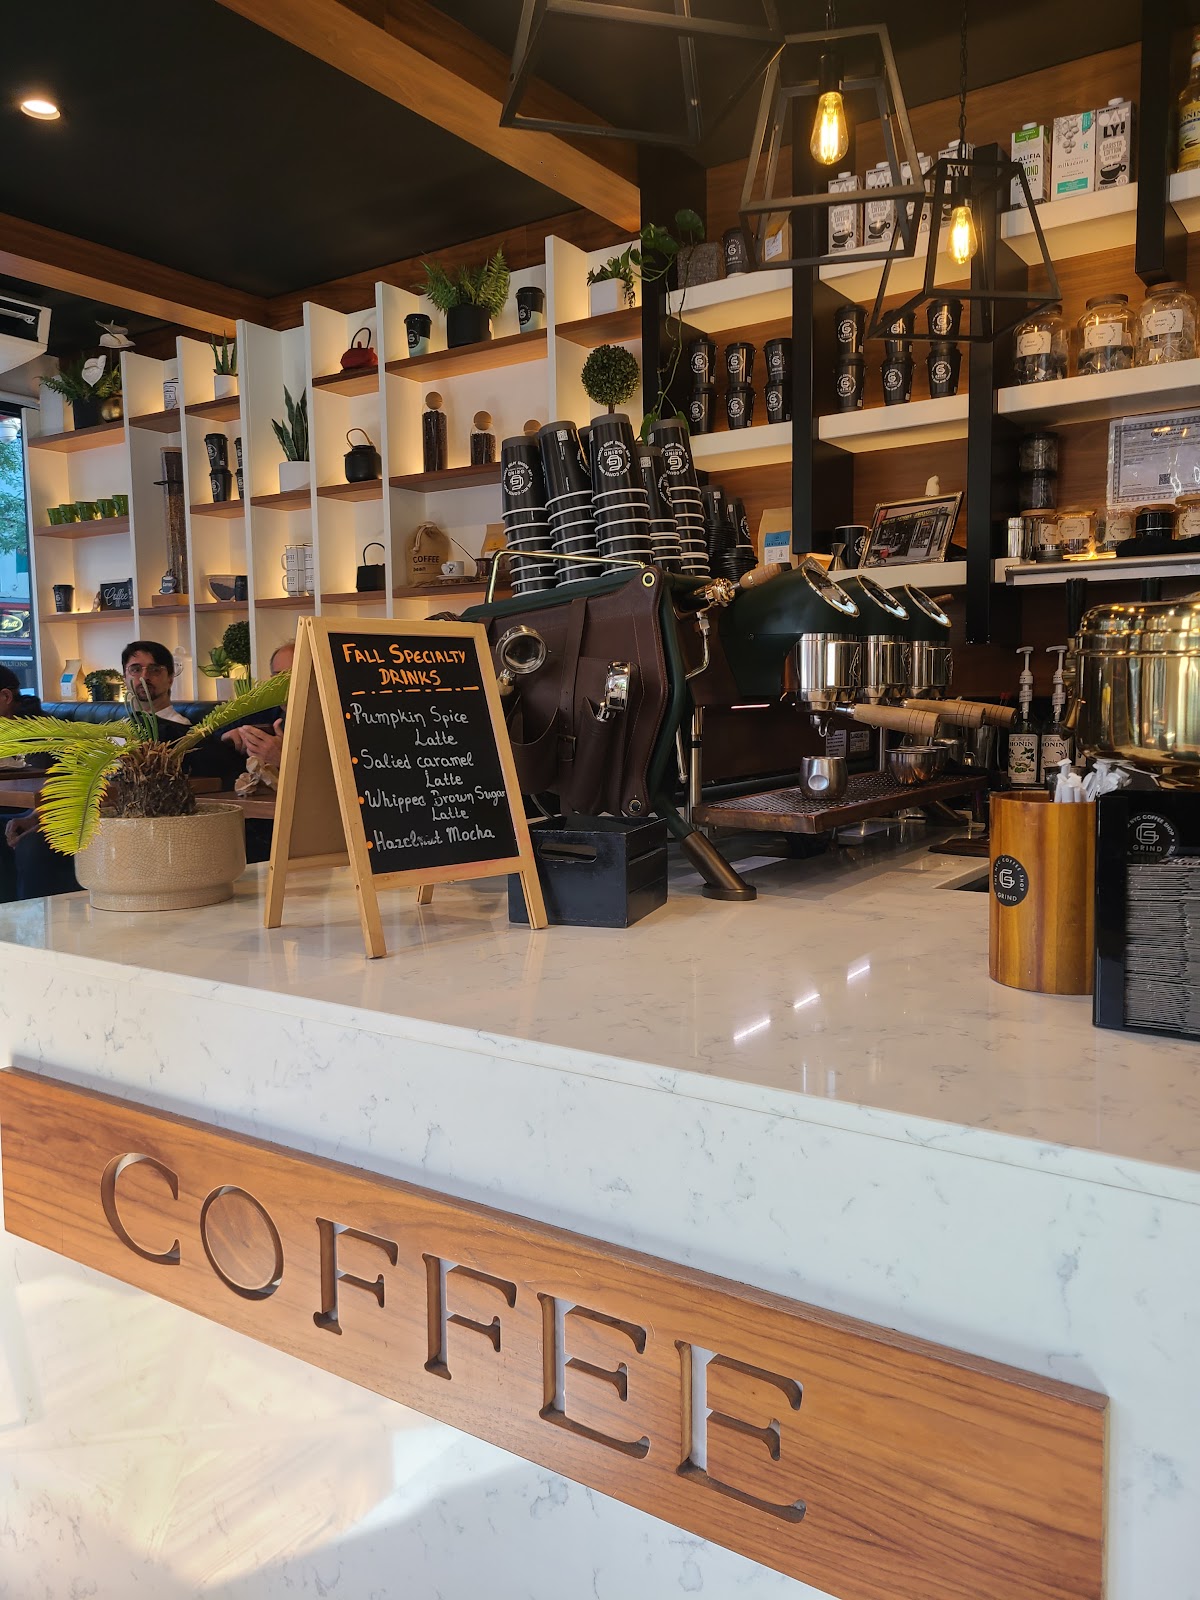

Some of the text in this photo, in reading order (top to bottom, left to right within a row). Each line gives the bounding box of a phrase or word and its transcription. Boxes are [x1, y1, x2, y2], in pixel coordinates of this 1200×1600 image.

[1103, 121, 1126, 139] LY!
[412, 555, 440, 564] COFFEE
[342, 643, 466, 664] FALL SPECIALTY
[378, 668, 441, 686] DRINKS
[350, 703, 469, 729] Pumpkin Spice
[415, 728, 458, 746] Latte
[416, 752, 474, 767] caramel
[424, 769, 464, 788] Latte
[474, 785, 506, 806] Sugar
[431, 806, 469, 822] Latte
[1142, 814, 1164, 825] COFFEE
[1163, 822, 1175, 836] SHOP
[373, 823, 496, 852] Hazelnut Mocha
[1132, 844, 1163, 852] GRIND
[1001, 857, 1022, 871] COFFEE
[997, 892, 1018, 902] GRIND
[100, 1152, 807, 1524] COFFEE
